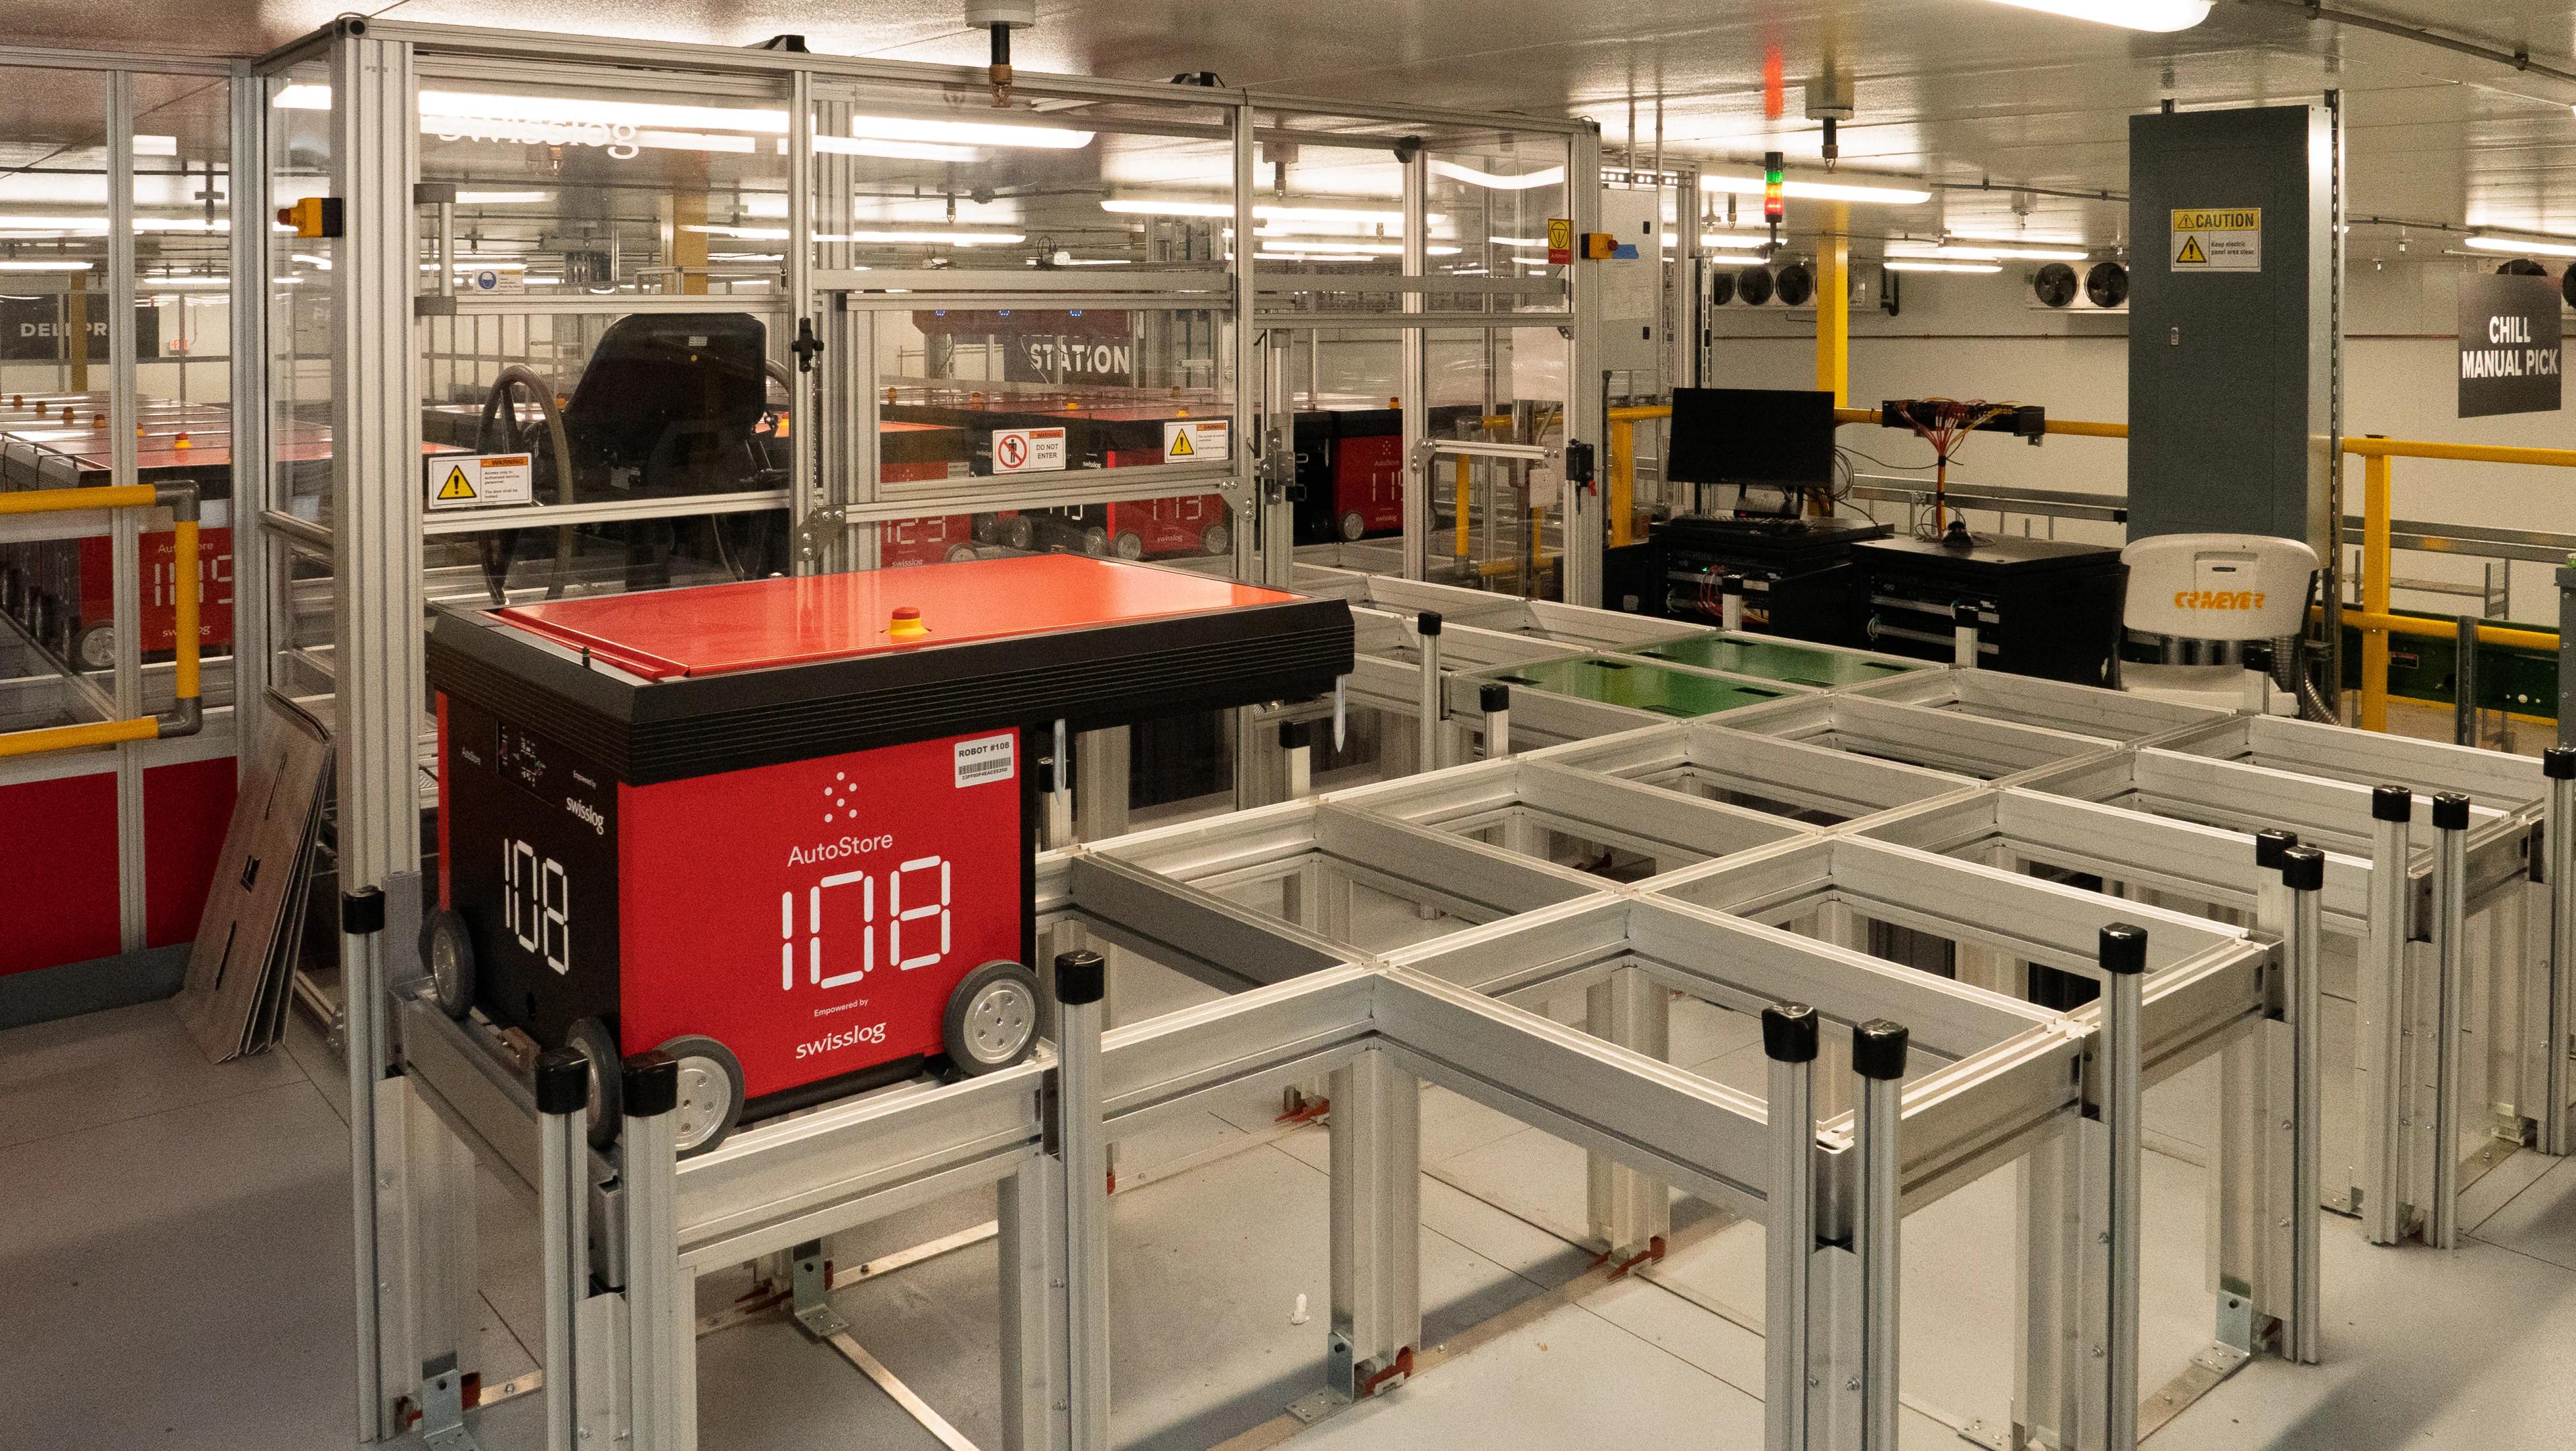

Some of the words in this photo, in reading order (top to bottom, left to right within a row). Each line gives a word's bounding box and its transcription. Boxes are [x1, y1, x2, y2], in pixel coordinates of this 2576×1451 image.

[2196, 213, 2254, 228] CAUTION
[2489, 316, 2531, 343] CHILL
[1030, 343, 1130, 374] STATION
[2463, 350, 2522, 378] MANUAL
[2526, 348, 2559, 376] PICK
[1083, 462, 1102, 470] swisslog
[1157, 535, 1183, 543] swisslog
[959, 746, 987, 757] ROBOT
[990, 742, 1010, 751] #108
[566, 797, 604, 835] swisslog
[787, 834, 894, 867] AutoStore
[504, 839, 570, 975] 108
[782, 855, 951, 991] 108
[814, 1000, 858, 1017] Empowered
[795, 1022, 887, 1059] swisslog
